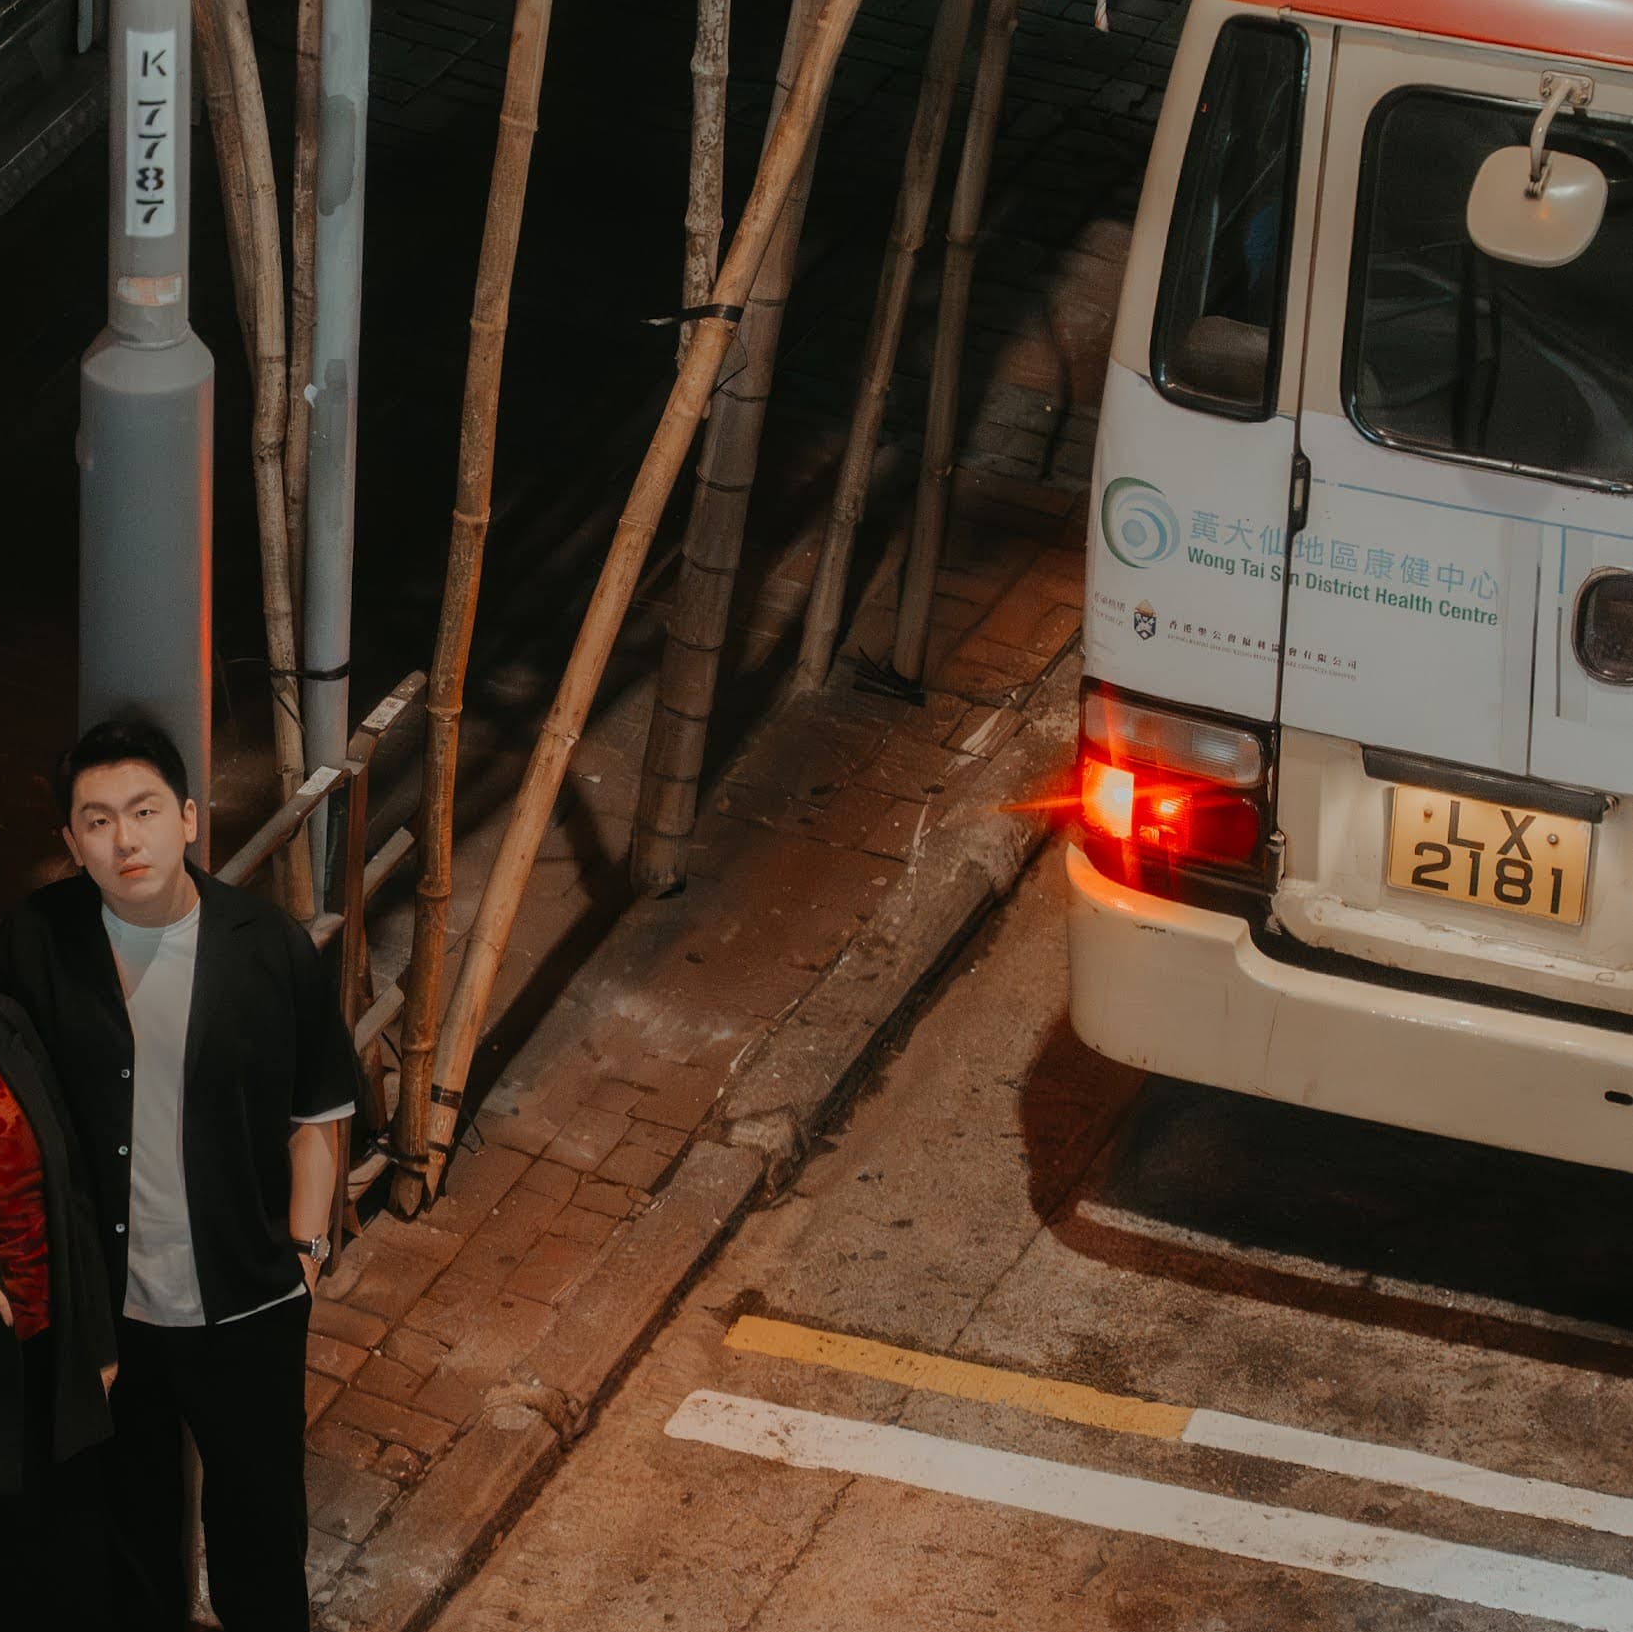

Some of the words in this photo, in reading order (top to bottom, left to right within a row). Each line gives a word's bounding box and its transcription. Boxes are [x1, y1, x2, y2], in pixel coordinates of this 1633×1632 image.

[1187, 545, 1235, 575] Wong
[1241, 558, 1265, 578] Tai
[1270, 565, 1299, 586] Sn
[1306, 572, 1370, 602] District
[1375, 589, 1432, 615] Health
[1438, 600, 1498, 627] Centre
[1190, 510, 1499, 600] 黃大仙地區康健中心
[1448, 800, 1536, 860] LX
[1411, 841, 1563, 920] 2181
